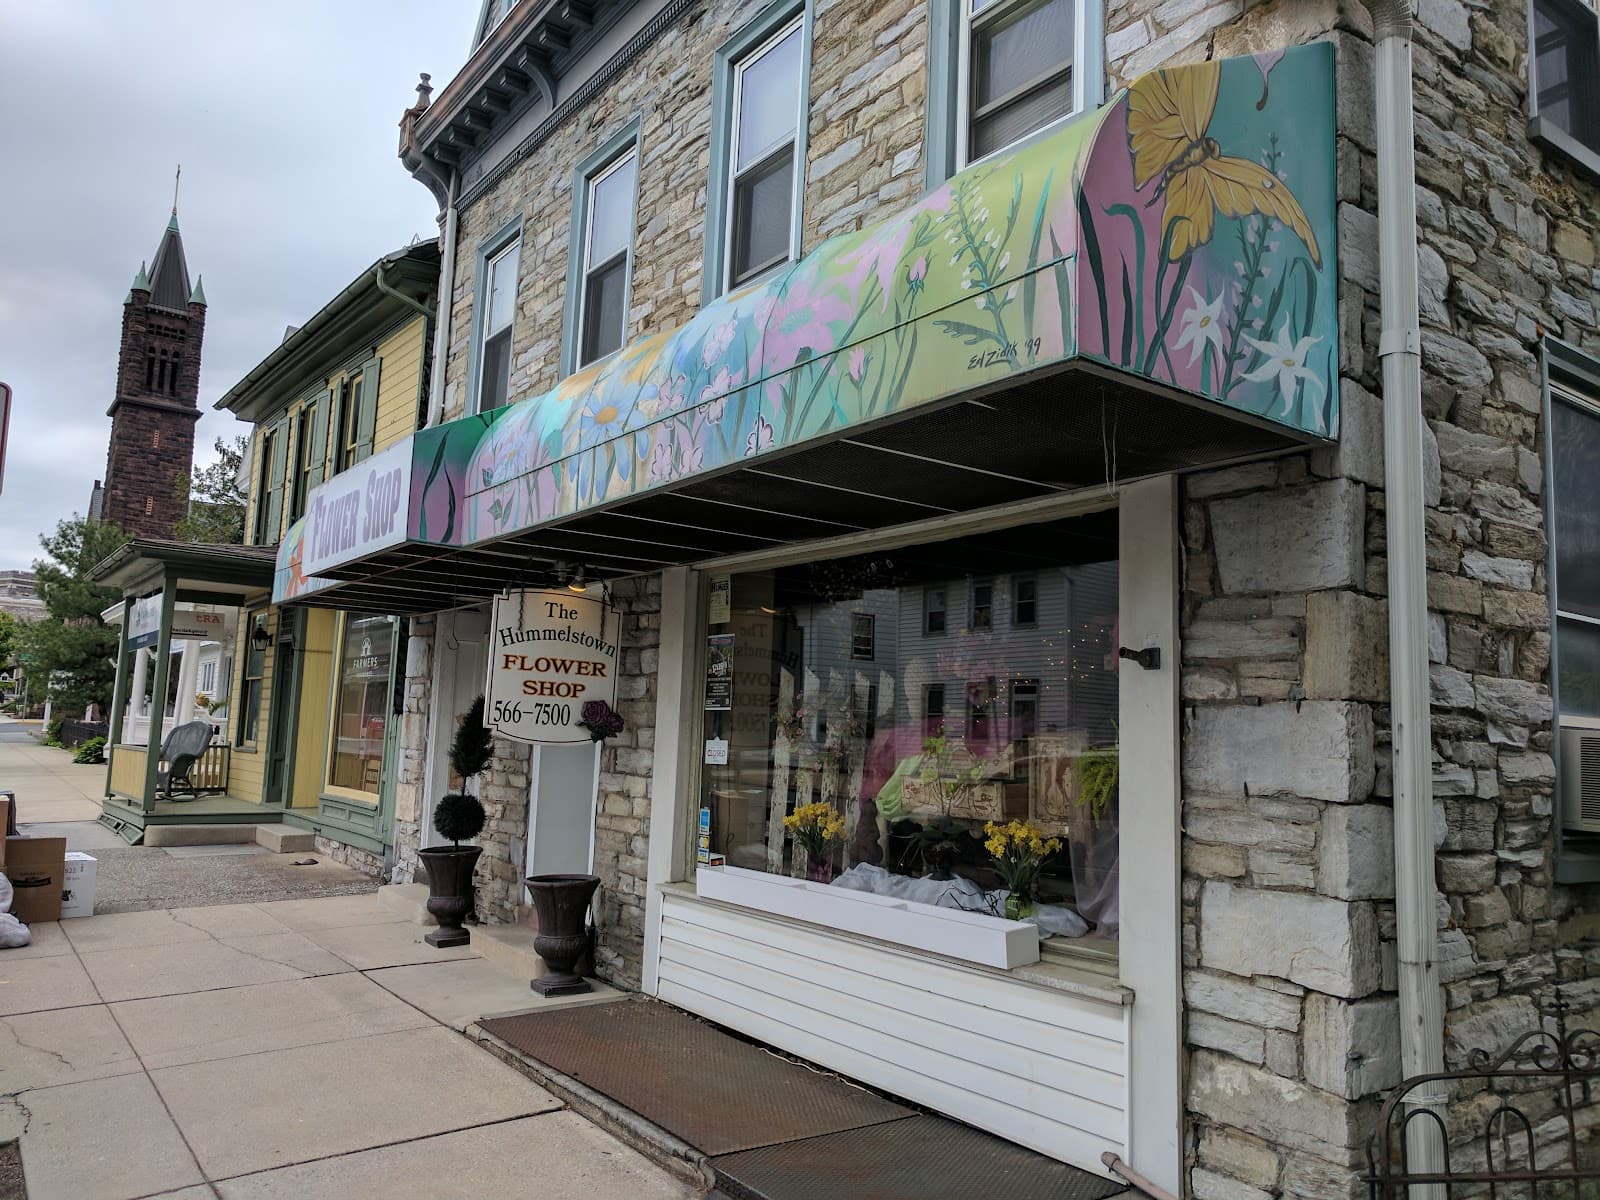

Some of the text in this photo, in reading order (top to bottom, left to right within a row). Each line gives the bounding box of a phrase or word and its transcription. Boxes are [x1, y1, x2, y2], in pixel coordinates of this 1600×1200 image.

[310, 467, 402, 563] FLOWER SHOP
[544, 601, 578, 620] The
[499, 625, 616, 658] Hummelstown
[353, 656, 378, 670] FARMERS
[502, 654, 608, 677] FLOWER
[522, 679, 586, 699] SHOP
[493, 700, 571, 727] 566-7500
